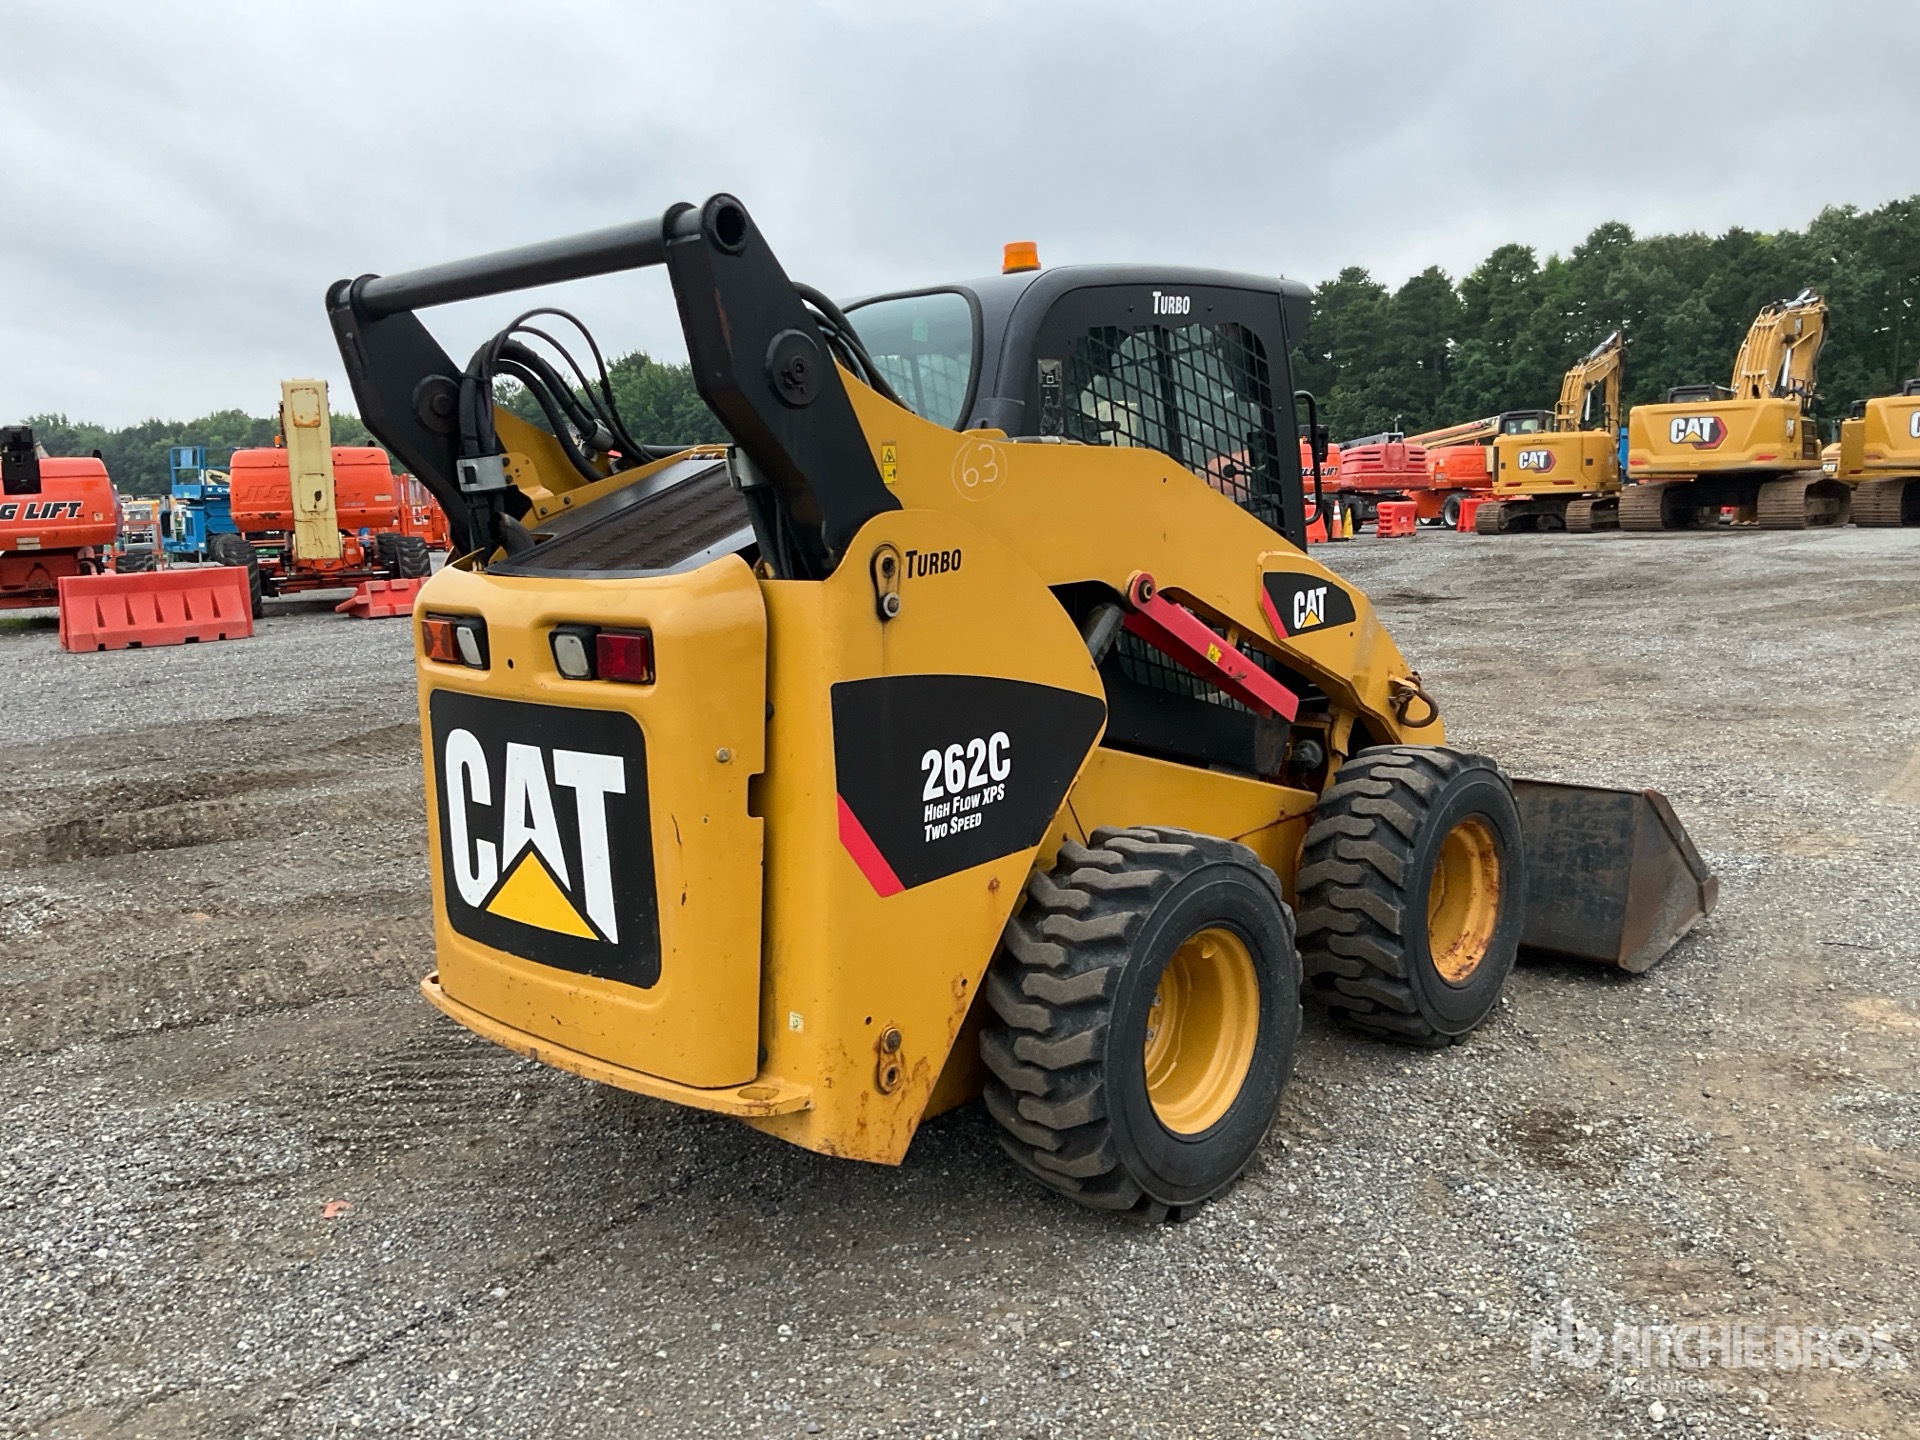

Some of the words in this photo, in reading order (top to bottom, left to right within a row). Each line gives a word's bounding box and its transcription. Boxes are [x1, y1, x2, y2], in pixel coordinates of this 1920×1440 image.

[1152, 290, 1190, 315] TURBO
[1671, 416, 1714, 444] CAT
[962, 443, 998, 487] 63
[1321, 466, 1339, 477] LIFT
[1519, 451, 1548, 470] CAT
[239, 484, 290, 505] JLG
[22, 501, 84, 521] LIFT
[905, 548, 962, 579] TURBO
[1293, 586, 1328, 630] CAT
[921, 731, 1011, 801] 262C
[924, 802, 950, 822] HIGH
[952, 793, 981, 814] FLOW
[982, 783, 1005, 805] XPS
[445, 728, 627, 945] CAT
[924, 823, 948, 842] TWO
[950, 812, 982, 834] SPEED
